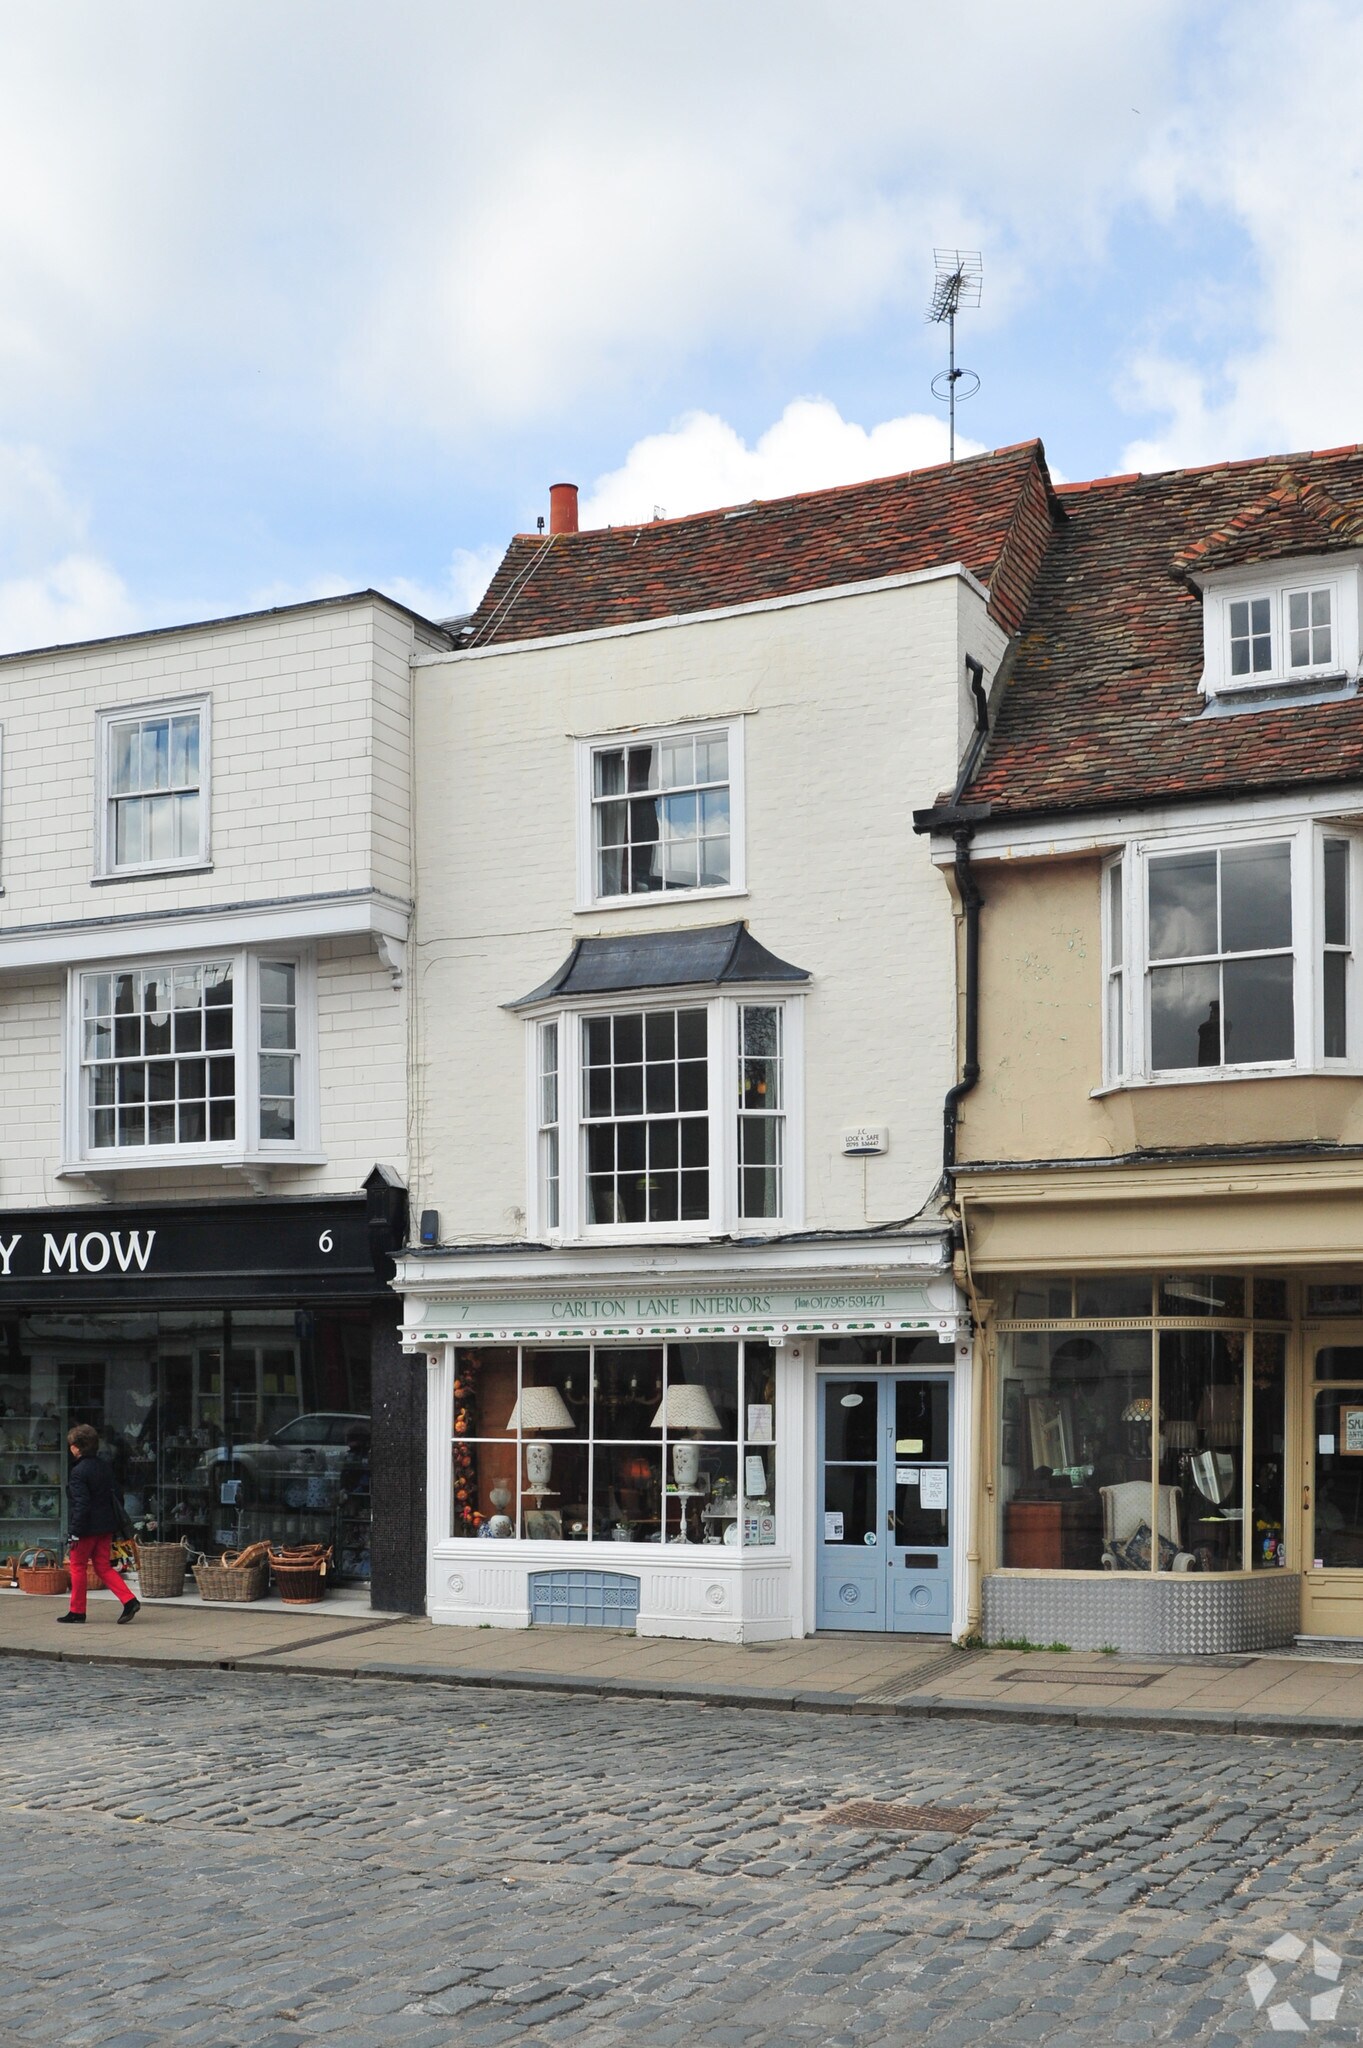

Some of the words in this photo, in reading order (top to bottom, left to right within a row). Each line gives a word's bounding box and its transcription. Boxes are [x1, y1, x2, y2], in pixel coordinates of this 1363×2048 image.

[318, 1229, 334, 1253] 6
[0, 1234, 22, 1275] Y
[42, 1230, 157, 1273] MOW
[461, 1306, 470, 1320] 7
[551, 1300, 626, 1318] CARLTON
[636, 1298, 680, 1317] LANE
[689, 1296, 771, 1316] INTERIORS
[886, 1427, 894, 1439] 7
